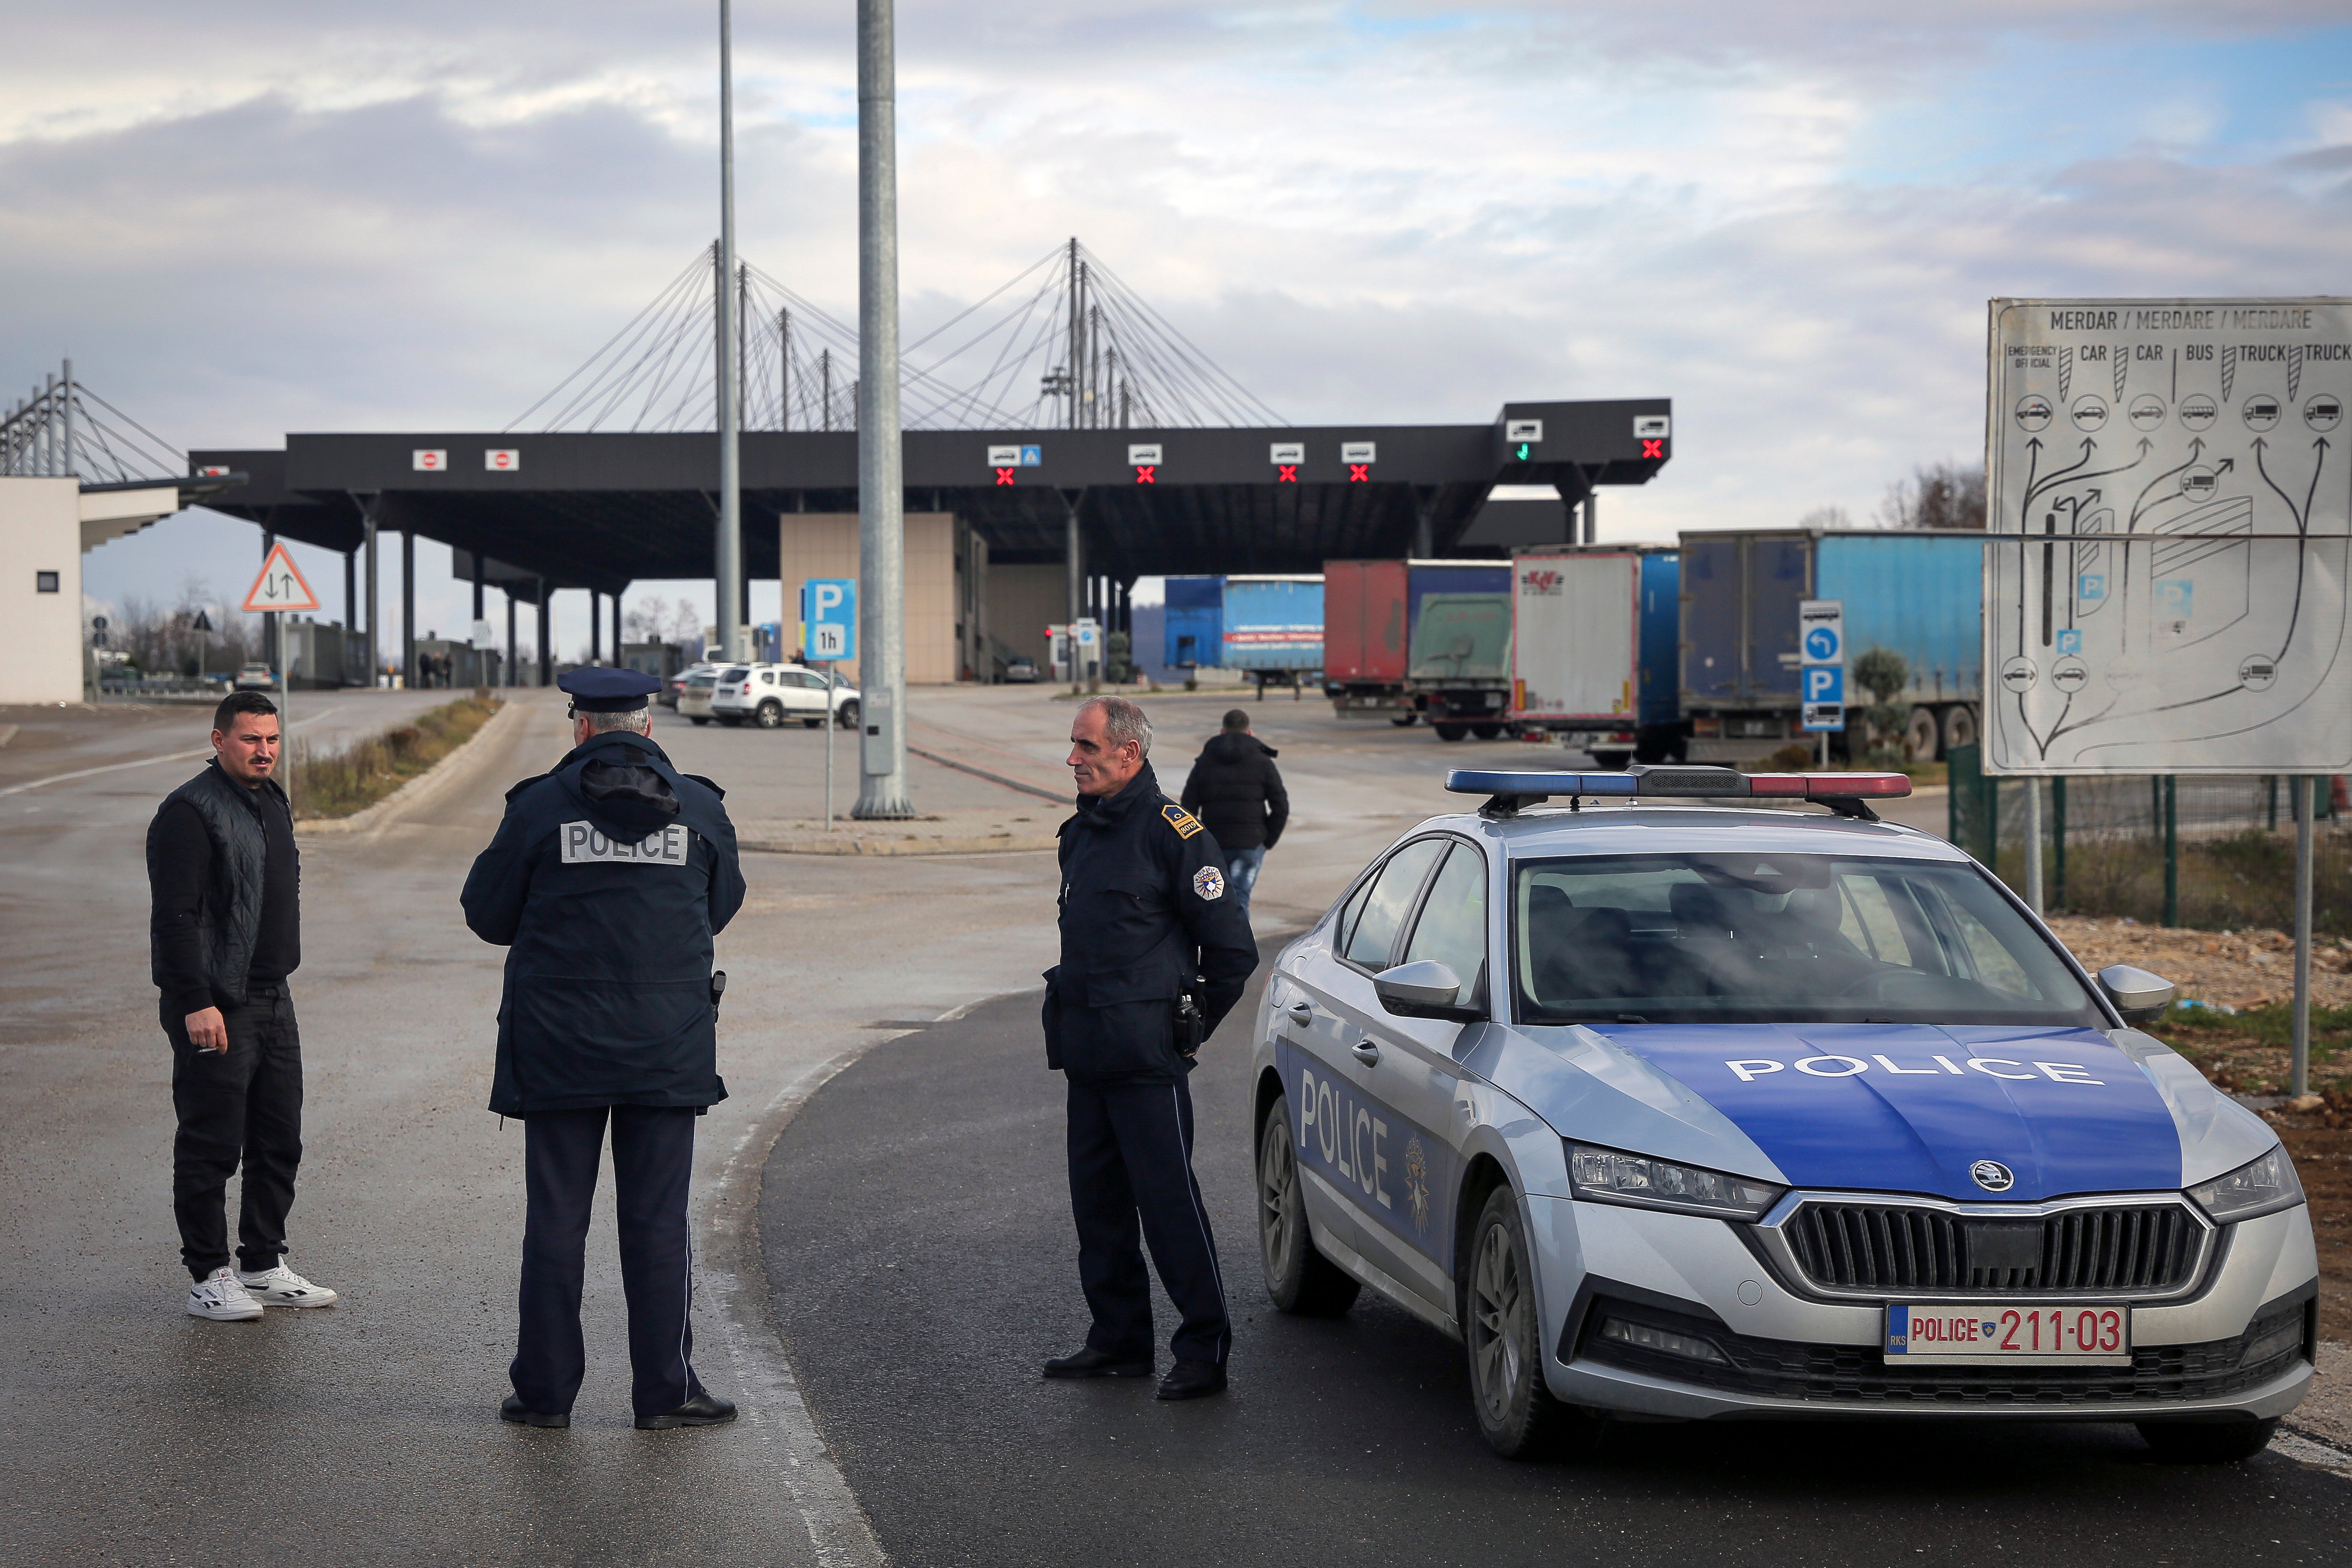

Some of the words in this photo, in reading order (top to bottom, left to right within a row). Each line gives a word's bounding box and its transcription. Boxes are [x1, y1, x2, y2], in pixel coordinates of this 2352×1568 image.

[2050, 311, 2117, 330] MERDAR
[2137, 310, 2214, 330] MERDARE
[2233, 310, 2312, 329] MERDARE
[2081, 345, 2107, 360] CAR
[2136, 345, 2163, 360] CAR
[2187, 345, 2214, 360] BUS
[2239, 345, 2286, 361] TRUCK
[2305, 345, 2352, 360] TRUCK
[2085, 579, 2098, 595] P
[816, 584, 843, 621] P
[821, 632, 837, 649] 1h
[2062, 633, 2075, 650] P
[1810, 671, 1833, 701] P
[1180, 822, 1196, 833] 8019
[1195, 867, 1219, 881] KOSOVO
[1724, 1054, 2106, 1086] POLICE
[1301, 1069, 1391, 1209] POLICE
[1890, 1335, 1906, 1346] RKS
[1912, 1317, 1979, 1342] POLICE
[2001, 1310, 2121, 1351] 211-03
